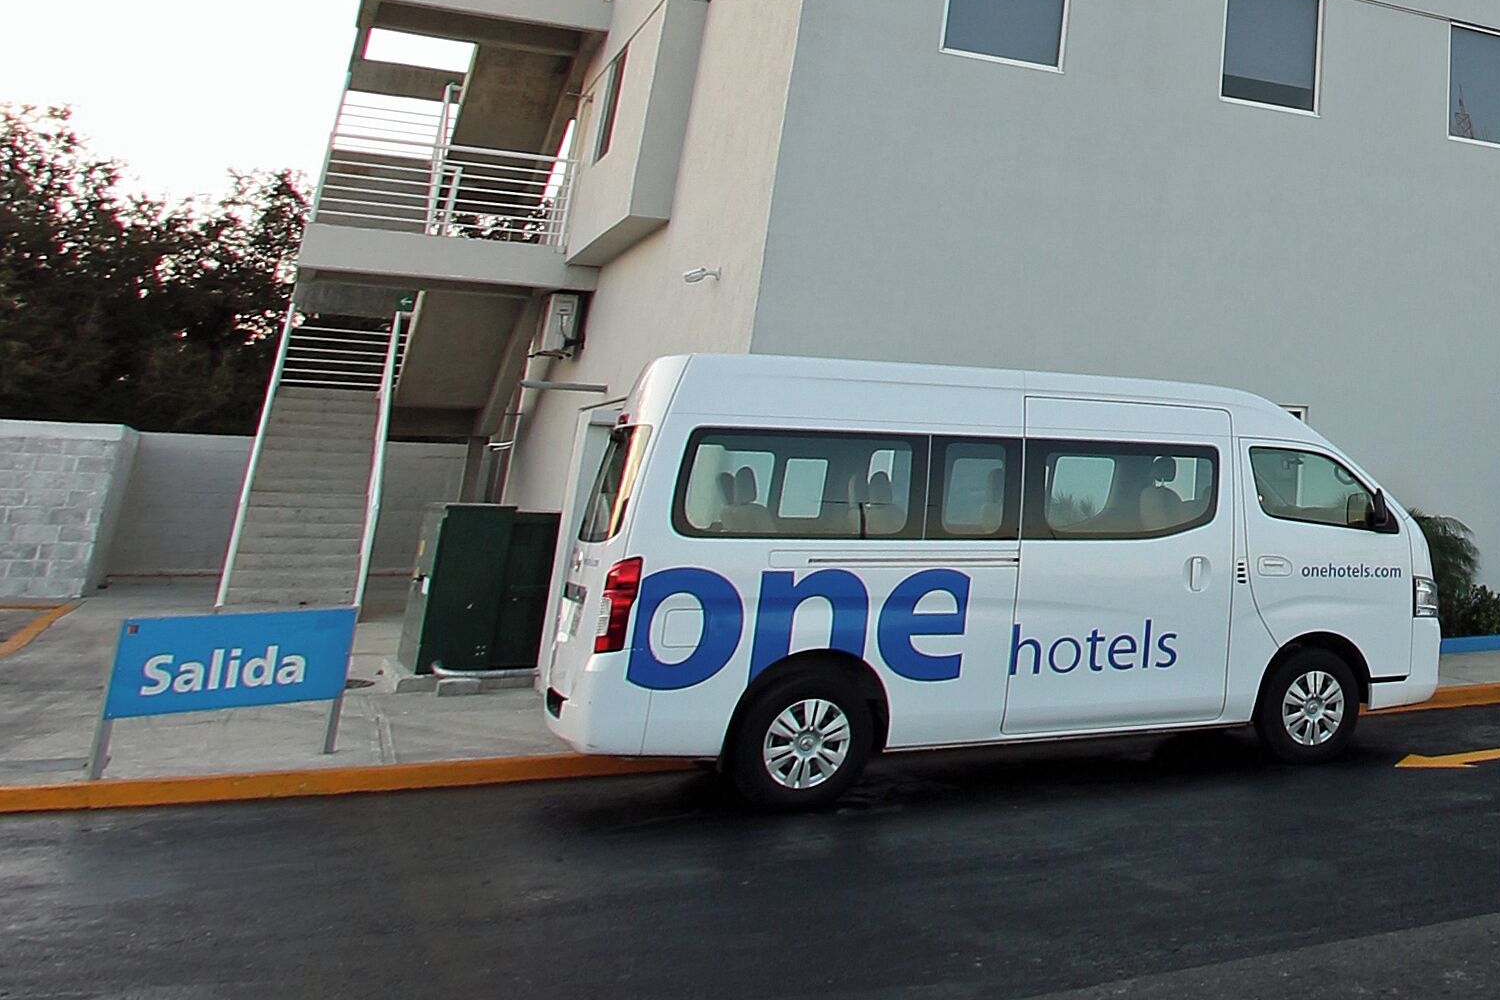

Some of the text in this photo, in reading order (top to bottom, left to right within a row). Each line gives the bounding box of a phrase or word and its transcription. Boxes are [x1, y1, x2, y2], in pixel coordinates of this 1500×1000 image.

[1301, 563, 1402, 578] onehotels.com
[625, 566, 971, 691] one
[1008, 619, 1178, 676] hotels
[139, 645, 307, 696] Salida
